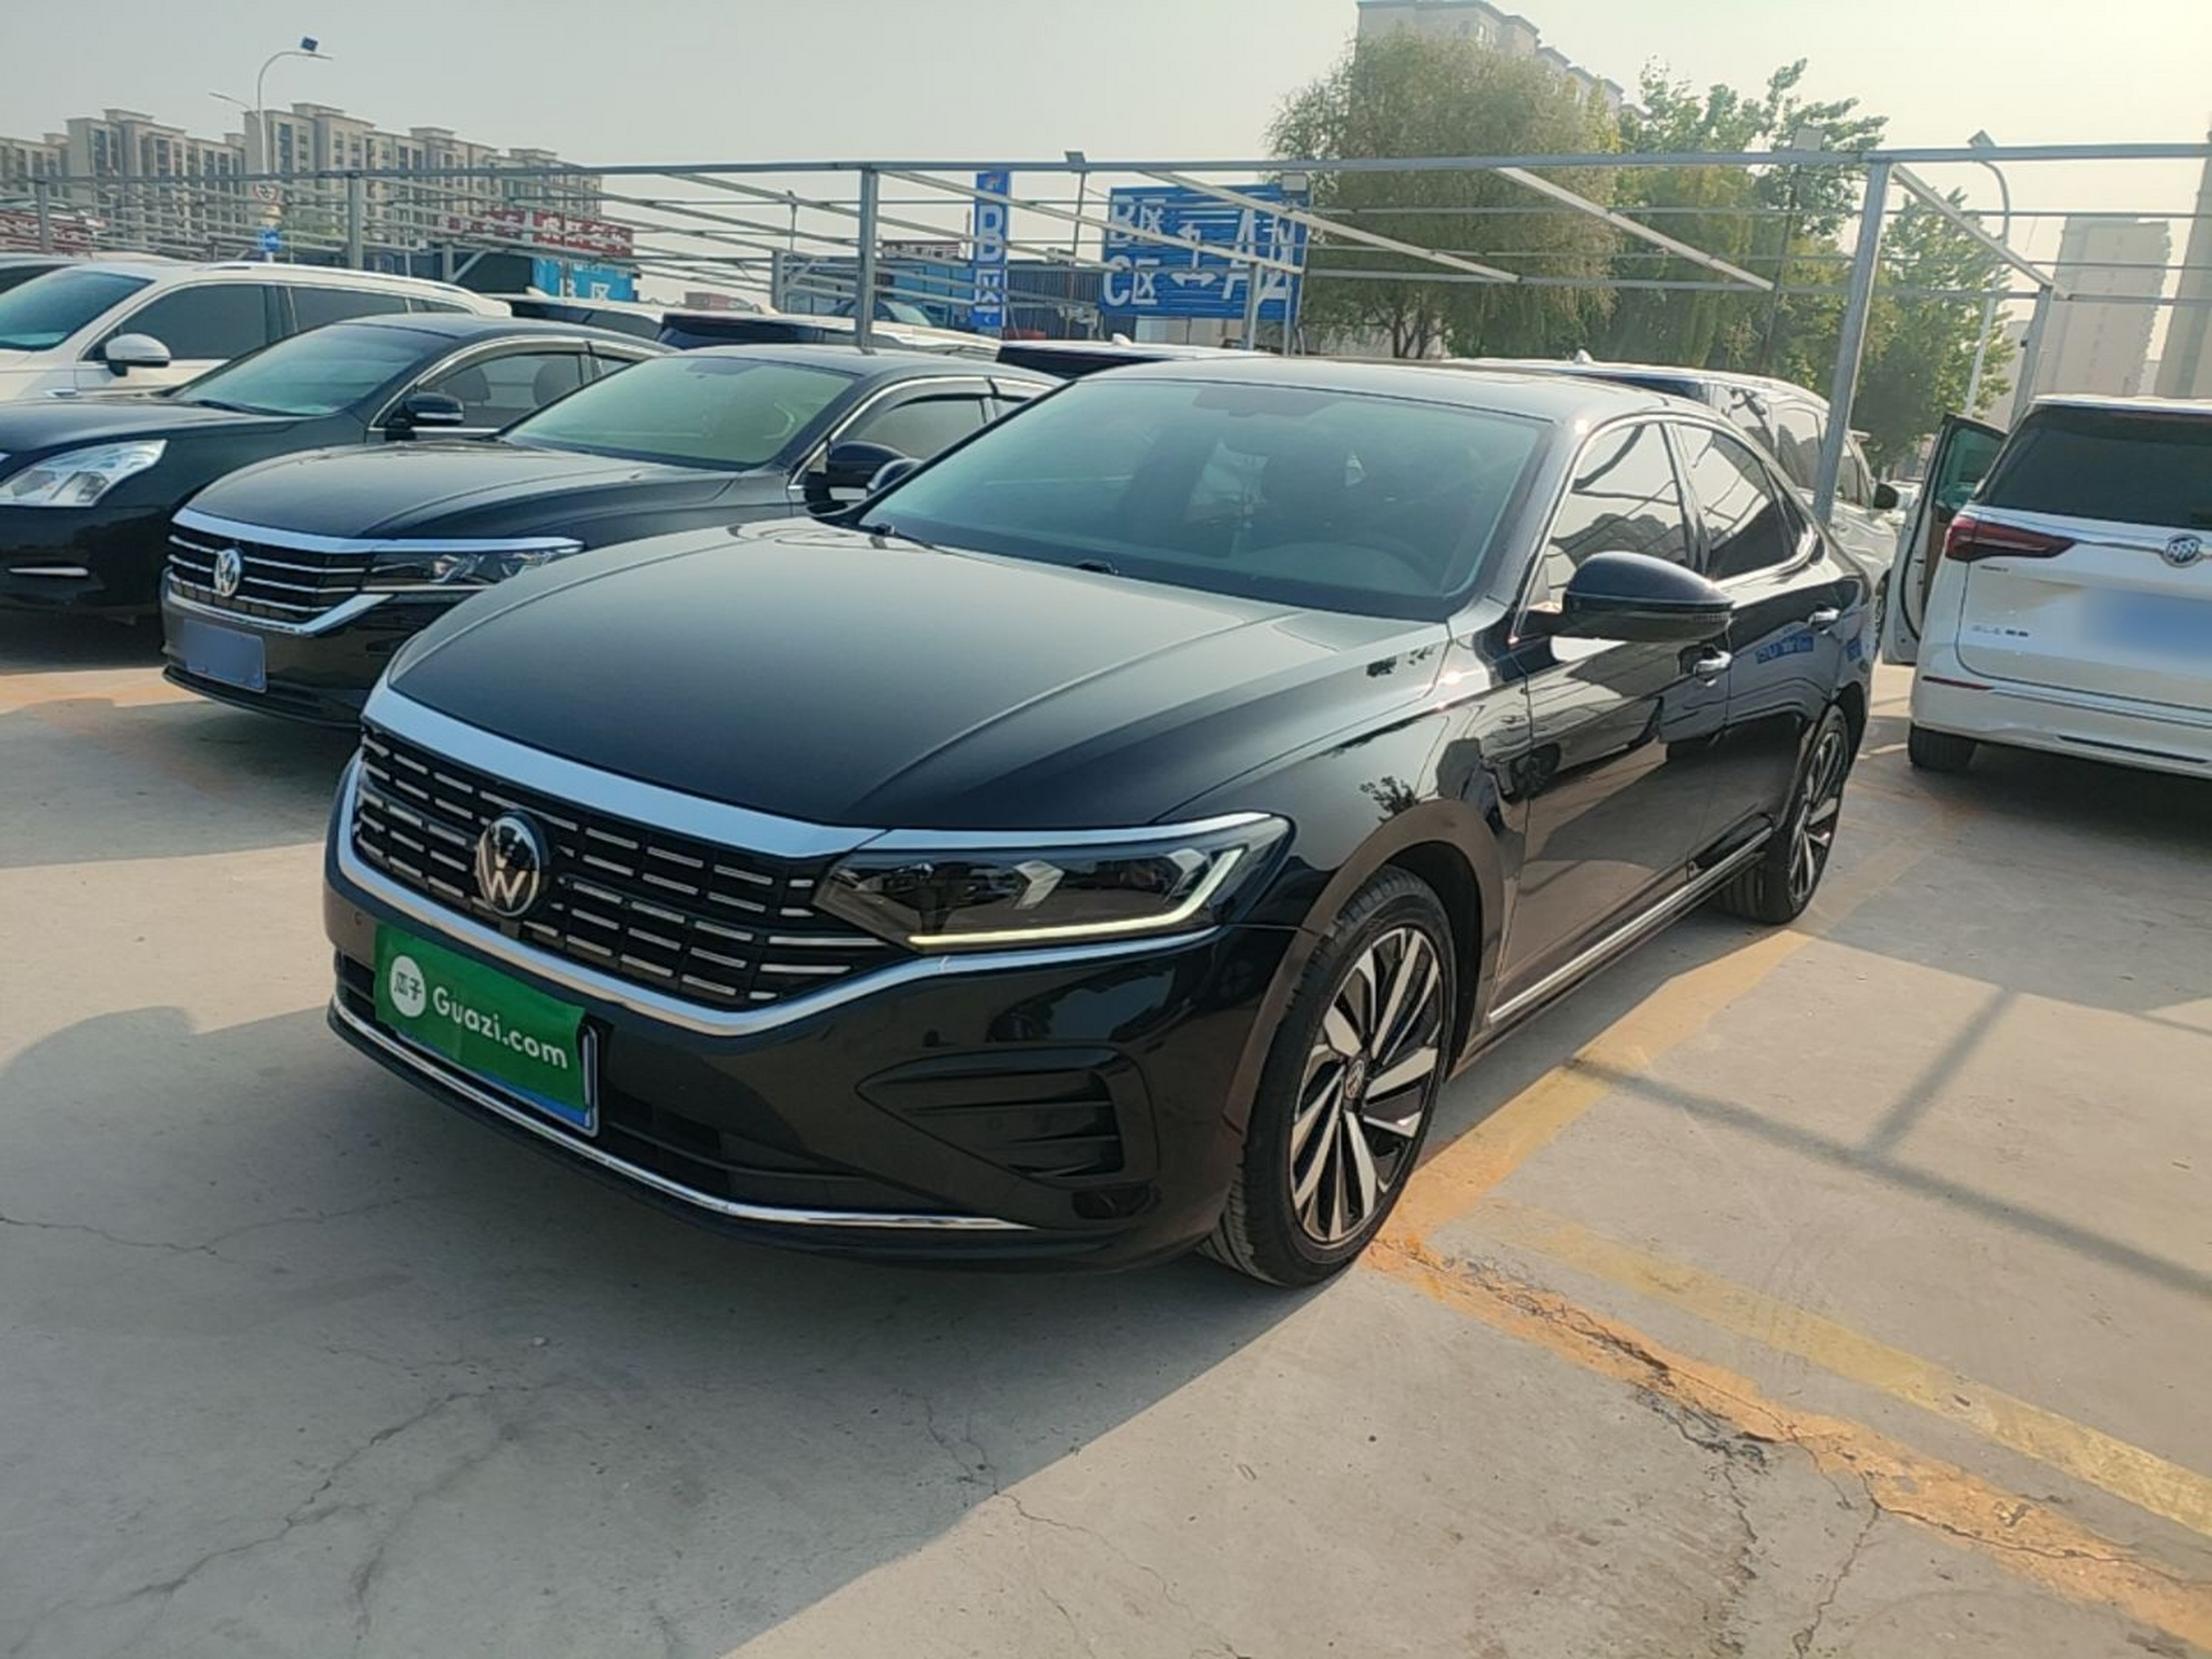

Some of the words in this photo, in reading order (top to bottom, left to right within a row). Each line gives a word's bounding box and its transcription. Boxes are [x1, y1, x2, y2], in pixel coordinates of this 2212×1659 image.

[974, 204, 1004, 313] B区
[1103, 255, 1160, 306] C区
[432, 985, 568, 1070] Guazi.com
